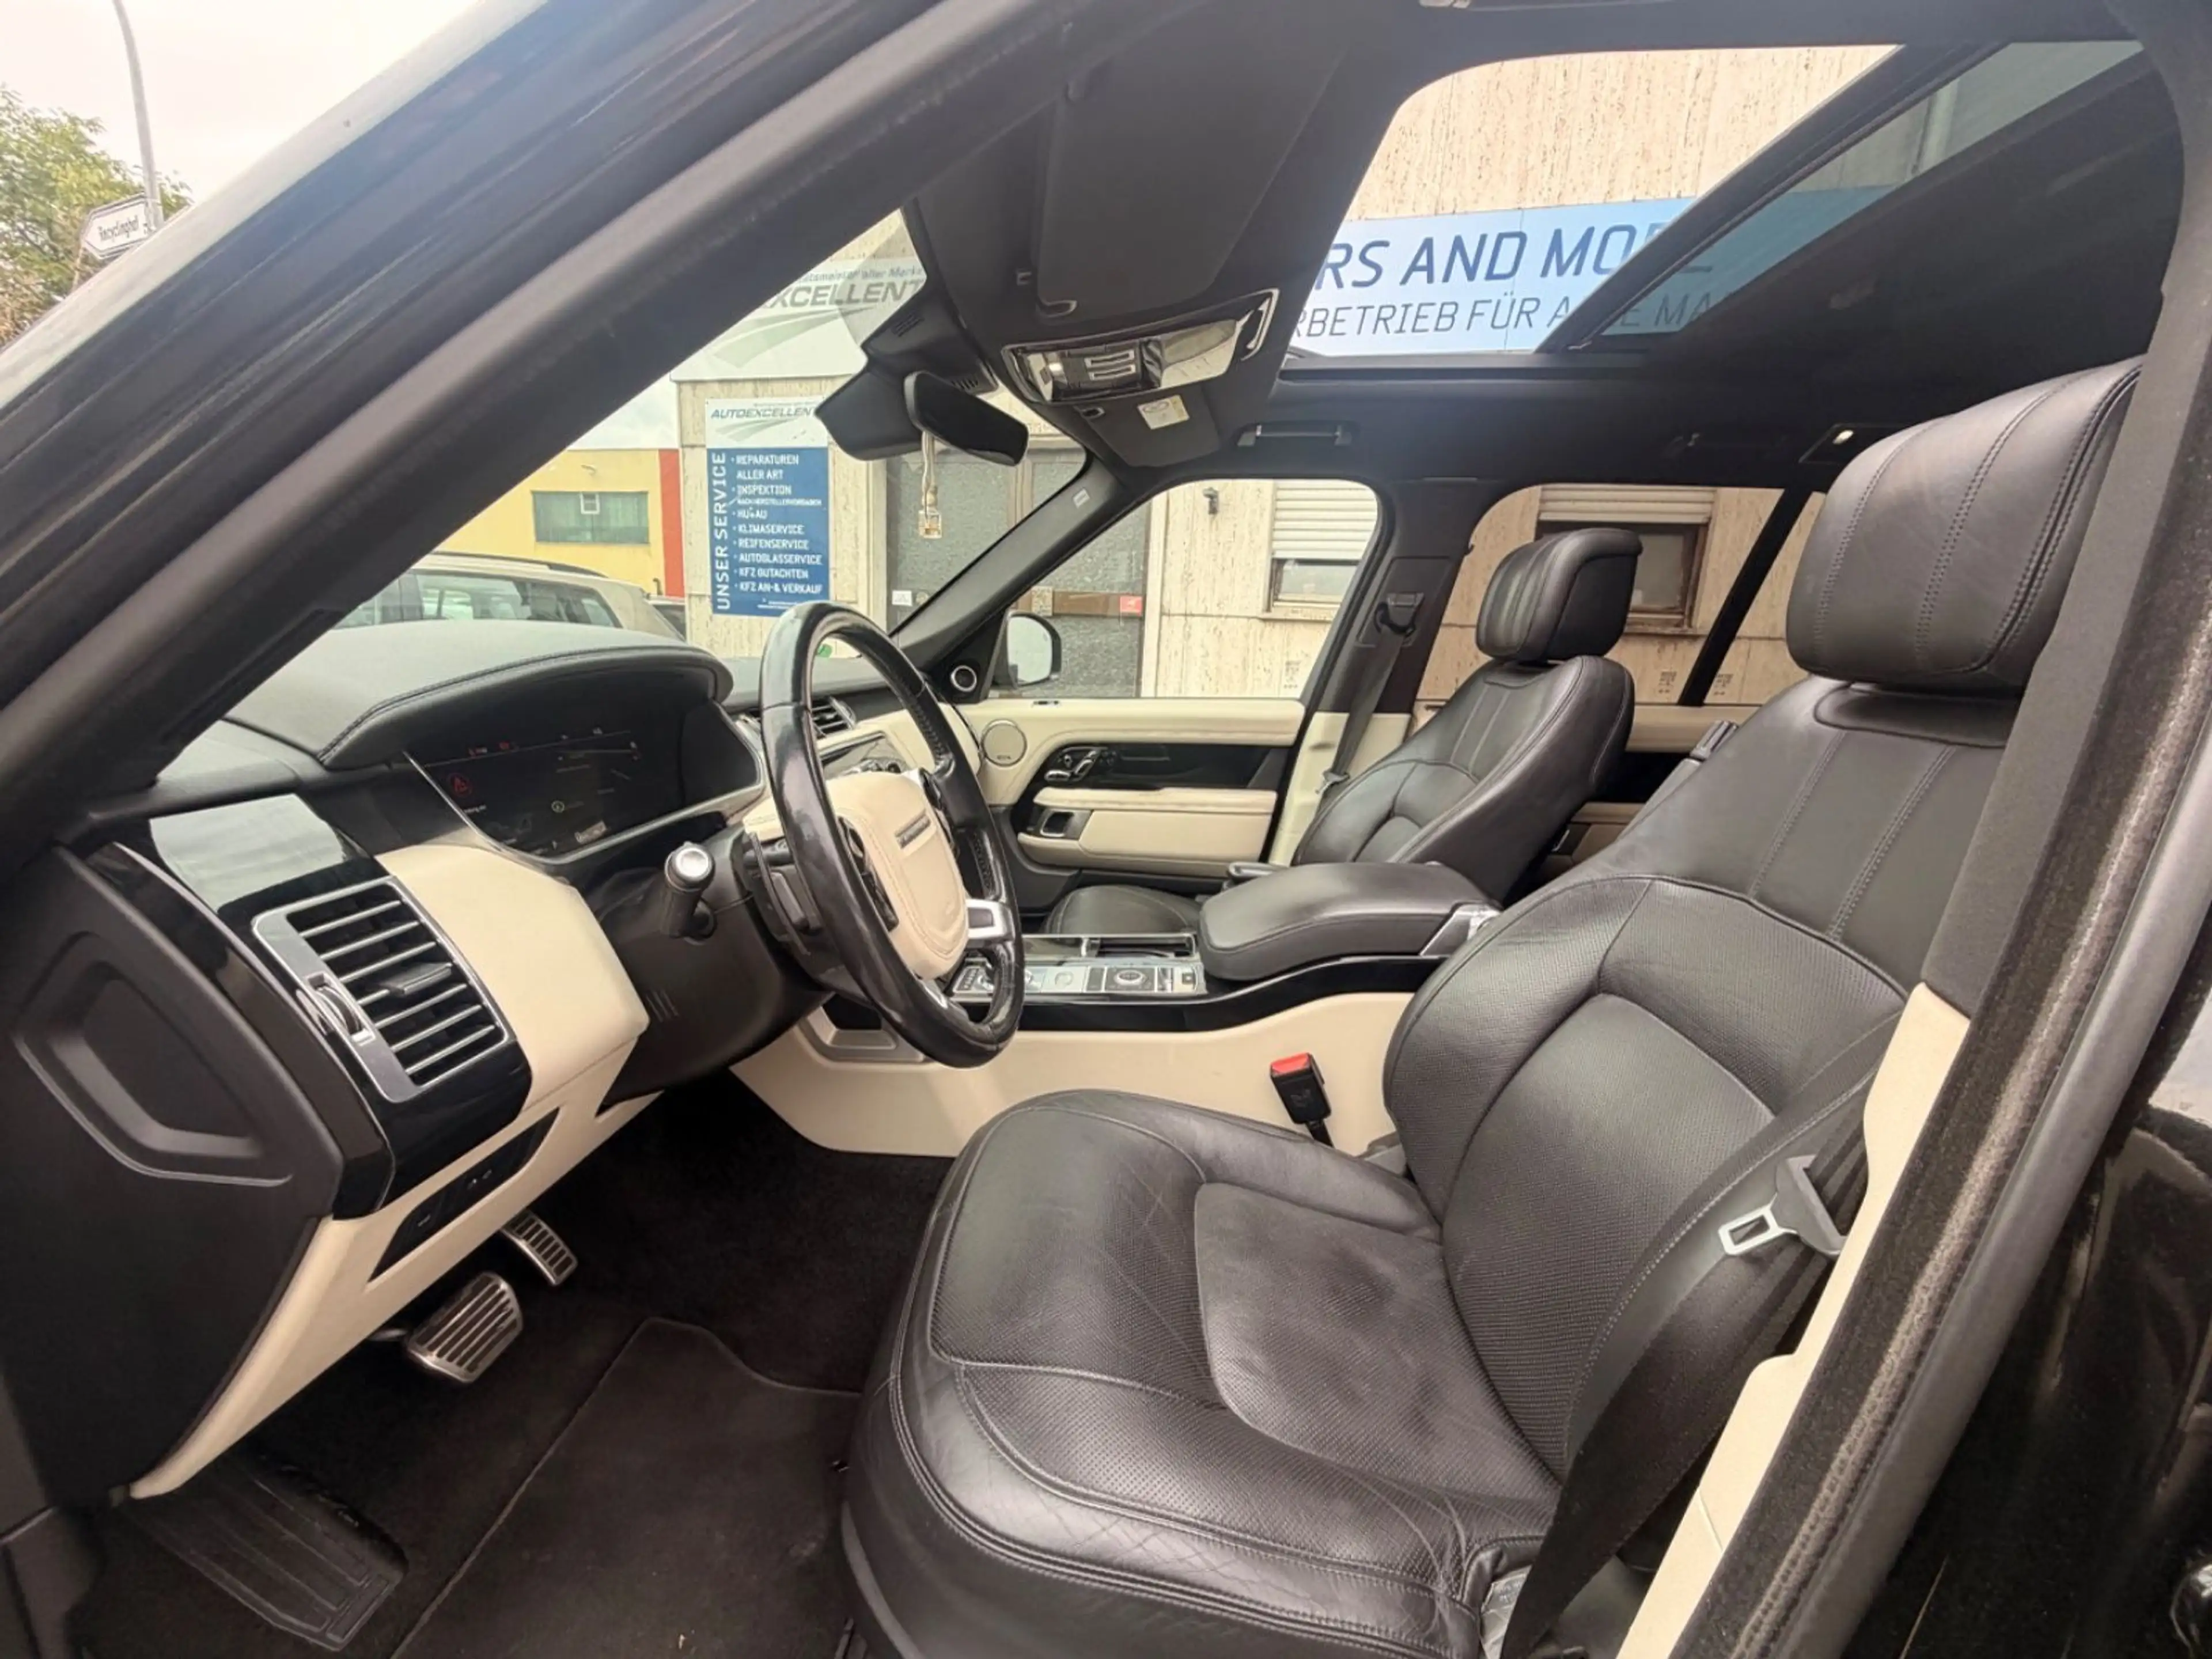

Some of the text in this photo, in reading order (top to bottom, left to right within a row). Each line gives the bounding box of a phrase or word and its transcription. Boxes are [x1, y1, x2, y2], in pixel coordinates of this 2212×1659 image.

[1399, 230, 1528, 286] AND
[759, 279, 925, 309] XCELLENT
[1467, 291, 1541, 331] FÜR
[711, 407, 813, 419] AUTOEXCELLEN
[736, 469, 783, 480] ALLER ART
[712, 453, 730, 610] UNSER SERVICE
[738, 524, 805, 535] KLIMASERVICE
[738, 539, 809, 550] REIFENSERVICE
[738, 553, 823, 565] AUTOGLASSERVICE
[738, 567, 809, 579] KFZ GUTACHTEN
[740, 581, 757, 592] KFZ
[783, 584, 823, 594] VERKAUF
